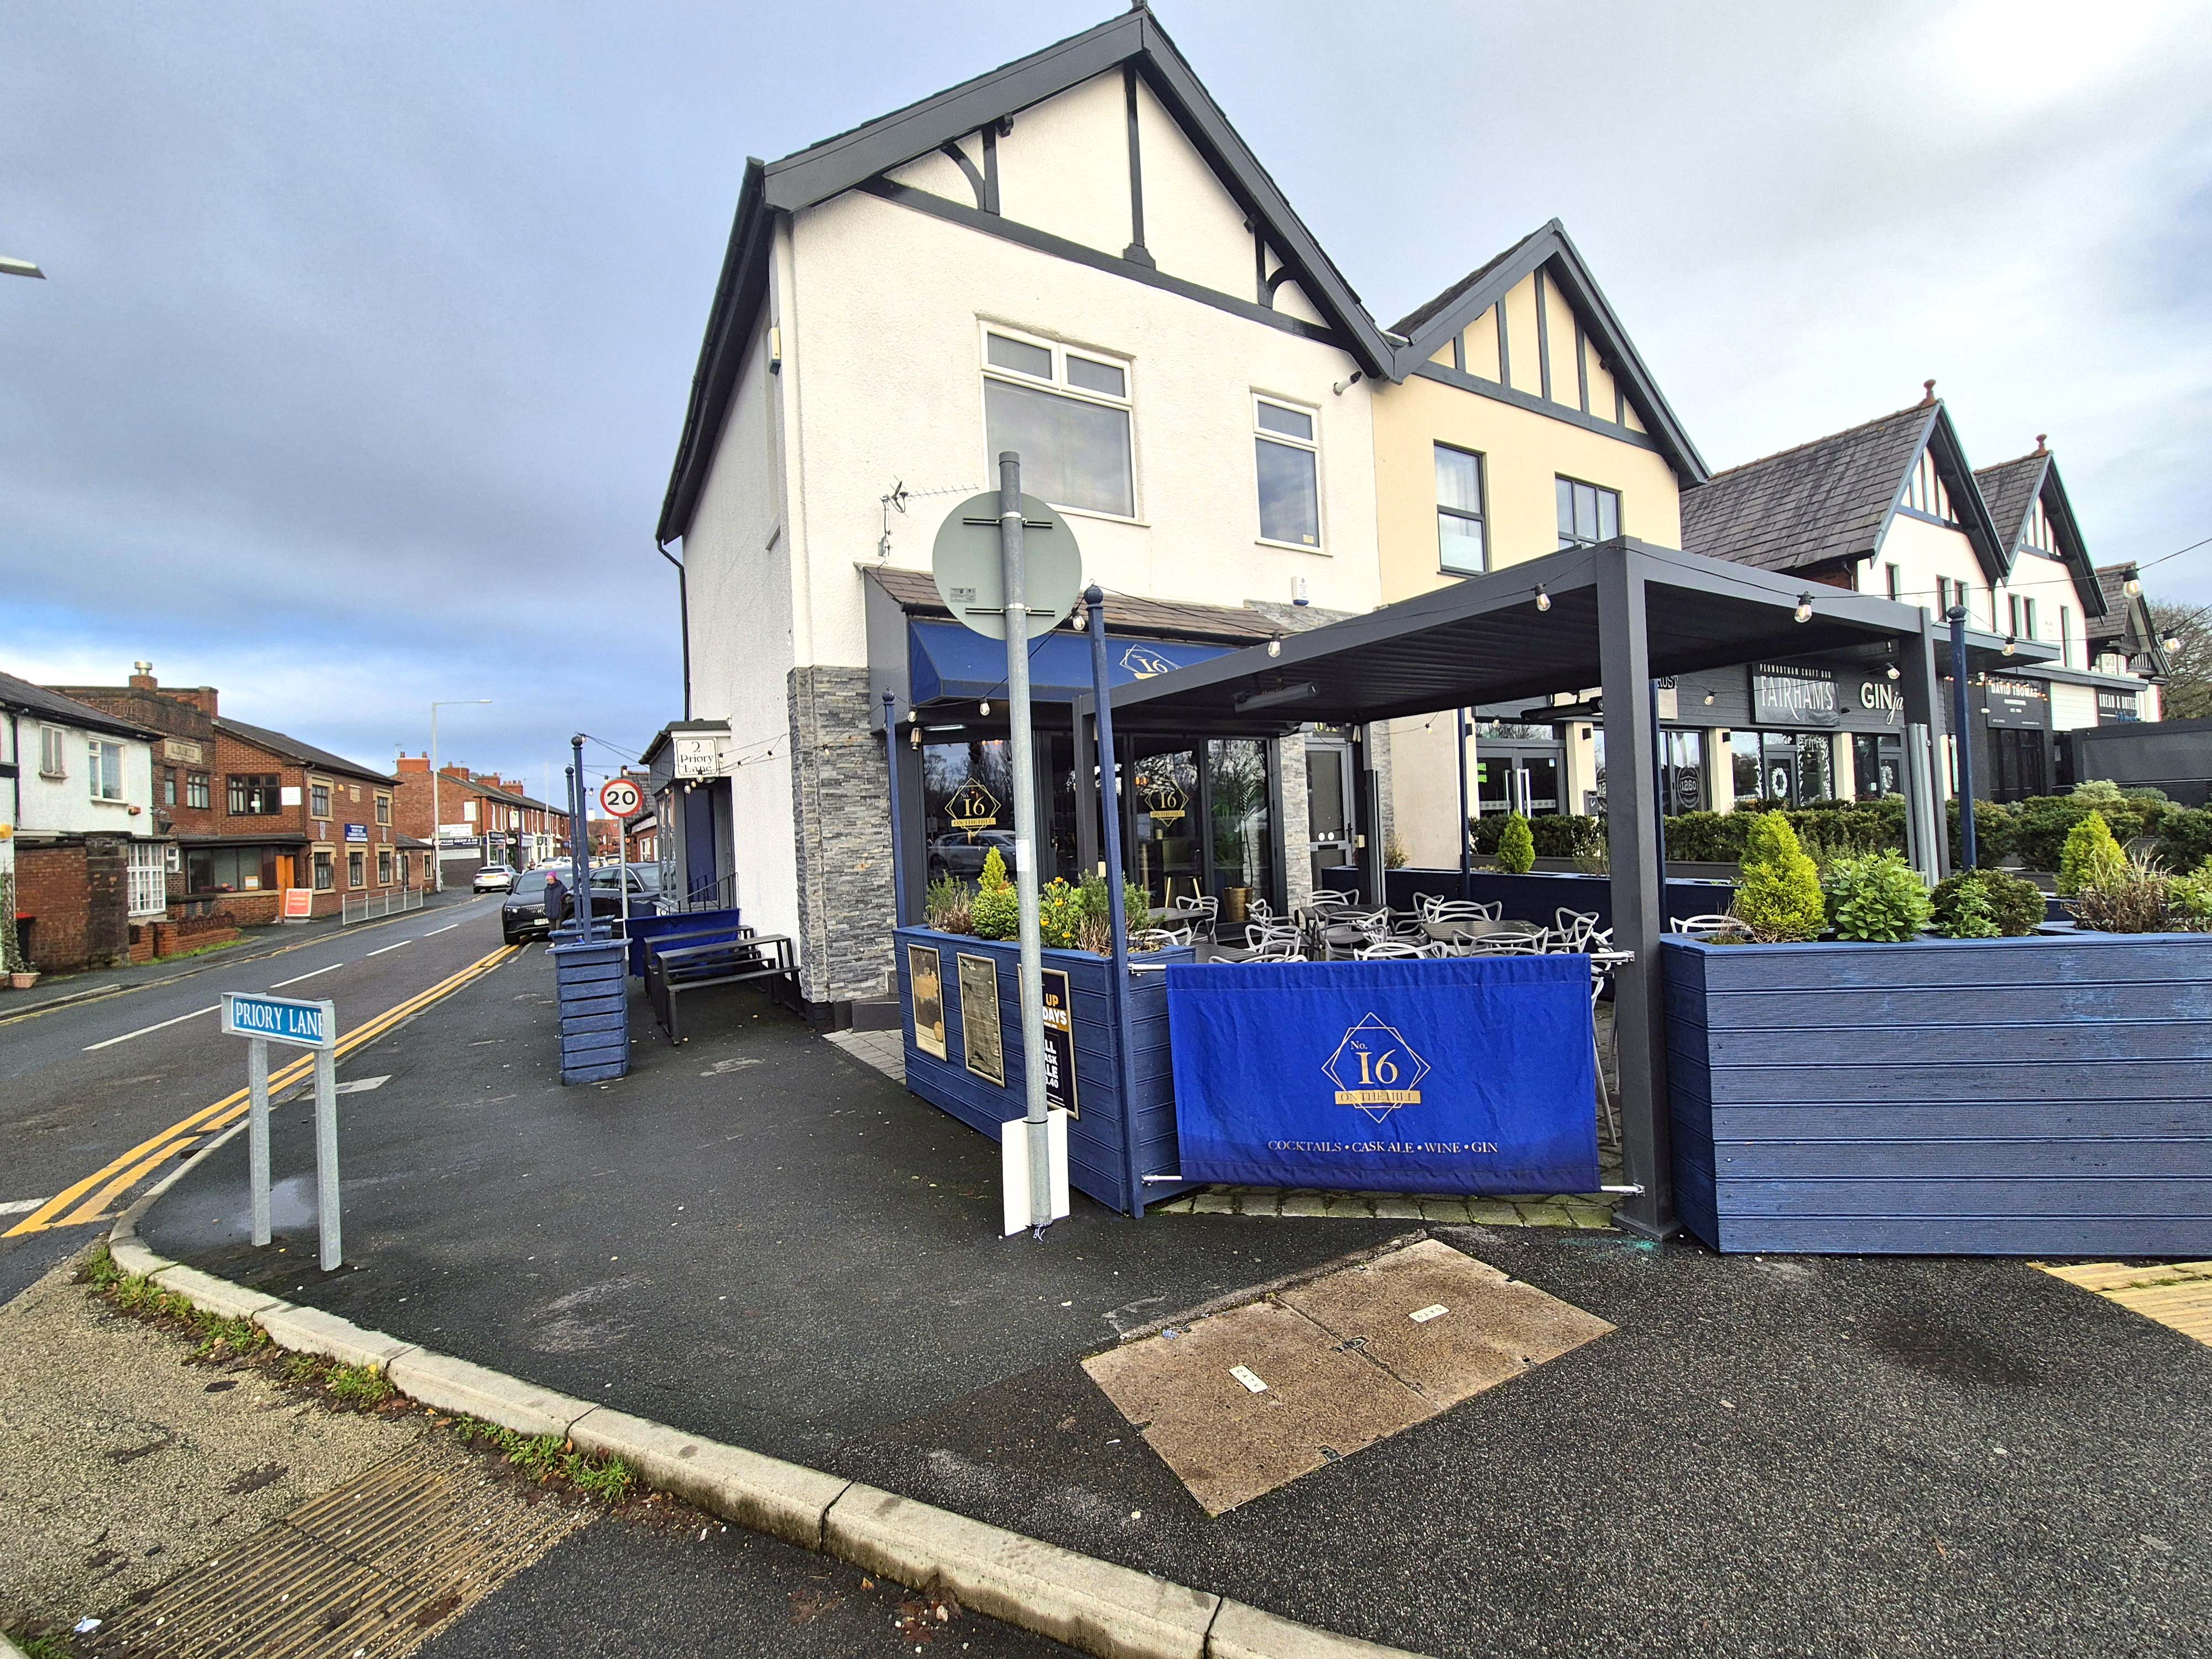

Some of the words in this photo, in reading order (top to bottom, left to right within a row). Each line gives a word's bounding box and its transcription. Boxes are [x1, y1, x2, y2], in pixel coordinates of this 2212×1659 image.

[1138, 659, 1168, 673] 16
[1991, 683, 2010, 695] DAVID
[691, 741, 701, 752] 2
[681, 754, 713, 764] Priory
[607, 791, 635, 805] 20
[1160, 791, 1177, 808] 16
[963, 796, 985, 816] 16
[1046, 993, 1059, 1006] UP
[236, 1002, 283, 1030] PRIORY
[289, 1009, 322, 1037] LANE
[1042, 1006, 1067, 1025] DAYS
[1044, 1039, 1057, 1055] LL
[1350, 1041, 1368, 1050] No.
[1044, 1052, 1058, 1066] ASK
[1045, 1063, 1058, 1079] LE
[1355, 1049, 1399, 1084] 16
[1340, 1092, 1357, 1102] ON
[1360, 1092, 1383, 1102] THE
[1384, 1092, 1416, 1102] HILL
[1268, 1140, 1342, 1152] COCKTAILS
[1352, 1141, 1385, 1152] CASK
[1387, 1142, 1415, 1153] ALE
[1423, 1142, 1461, 1153] WINE
[1471, 1141, 1498, 1153] GIN
